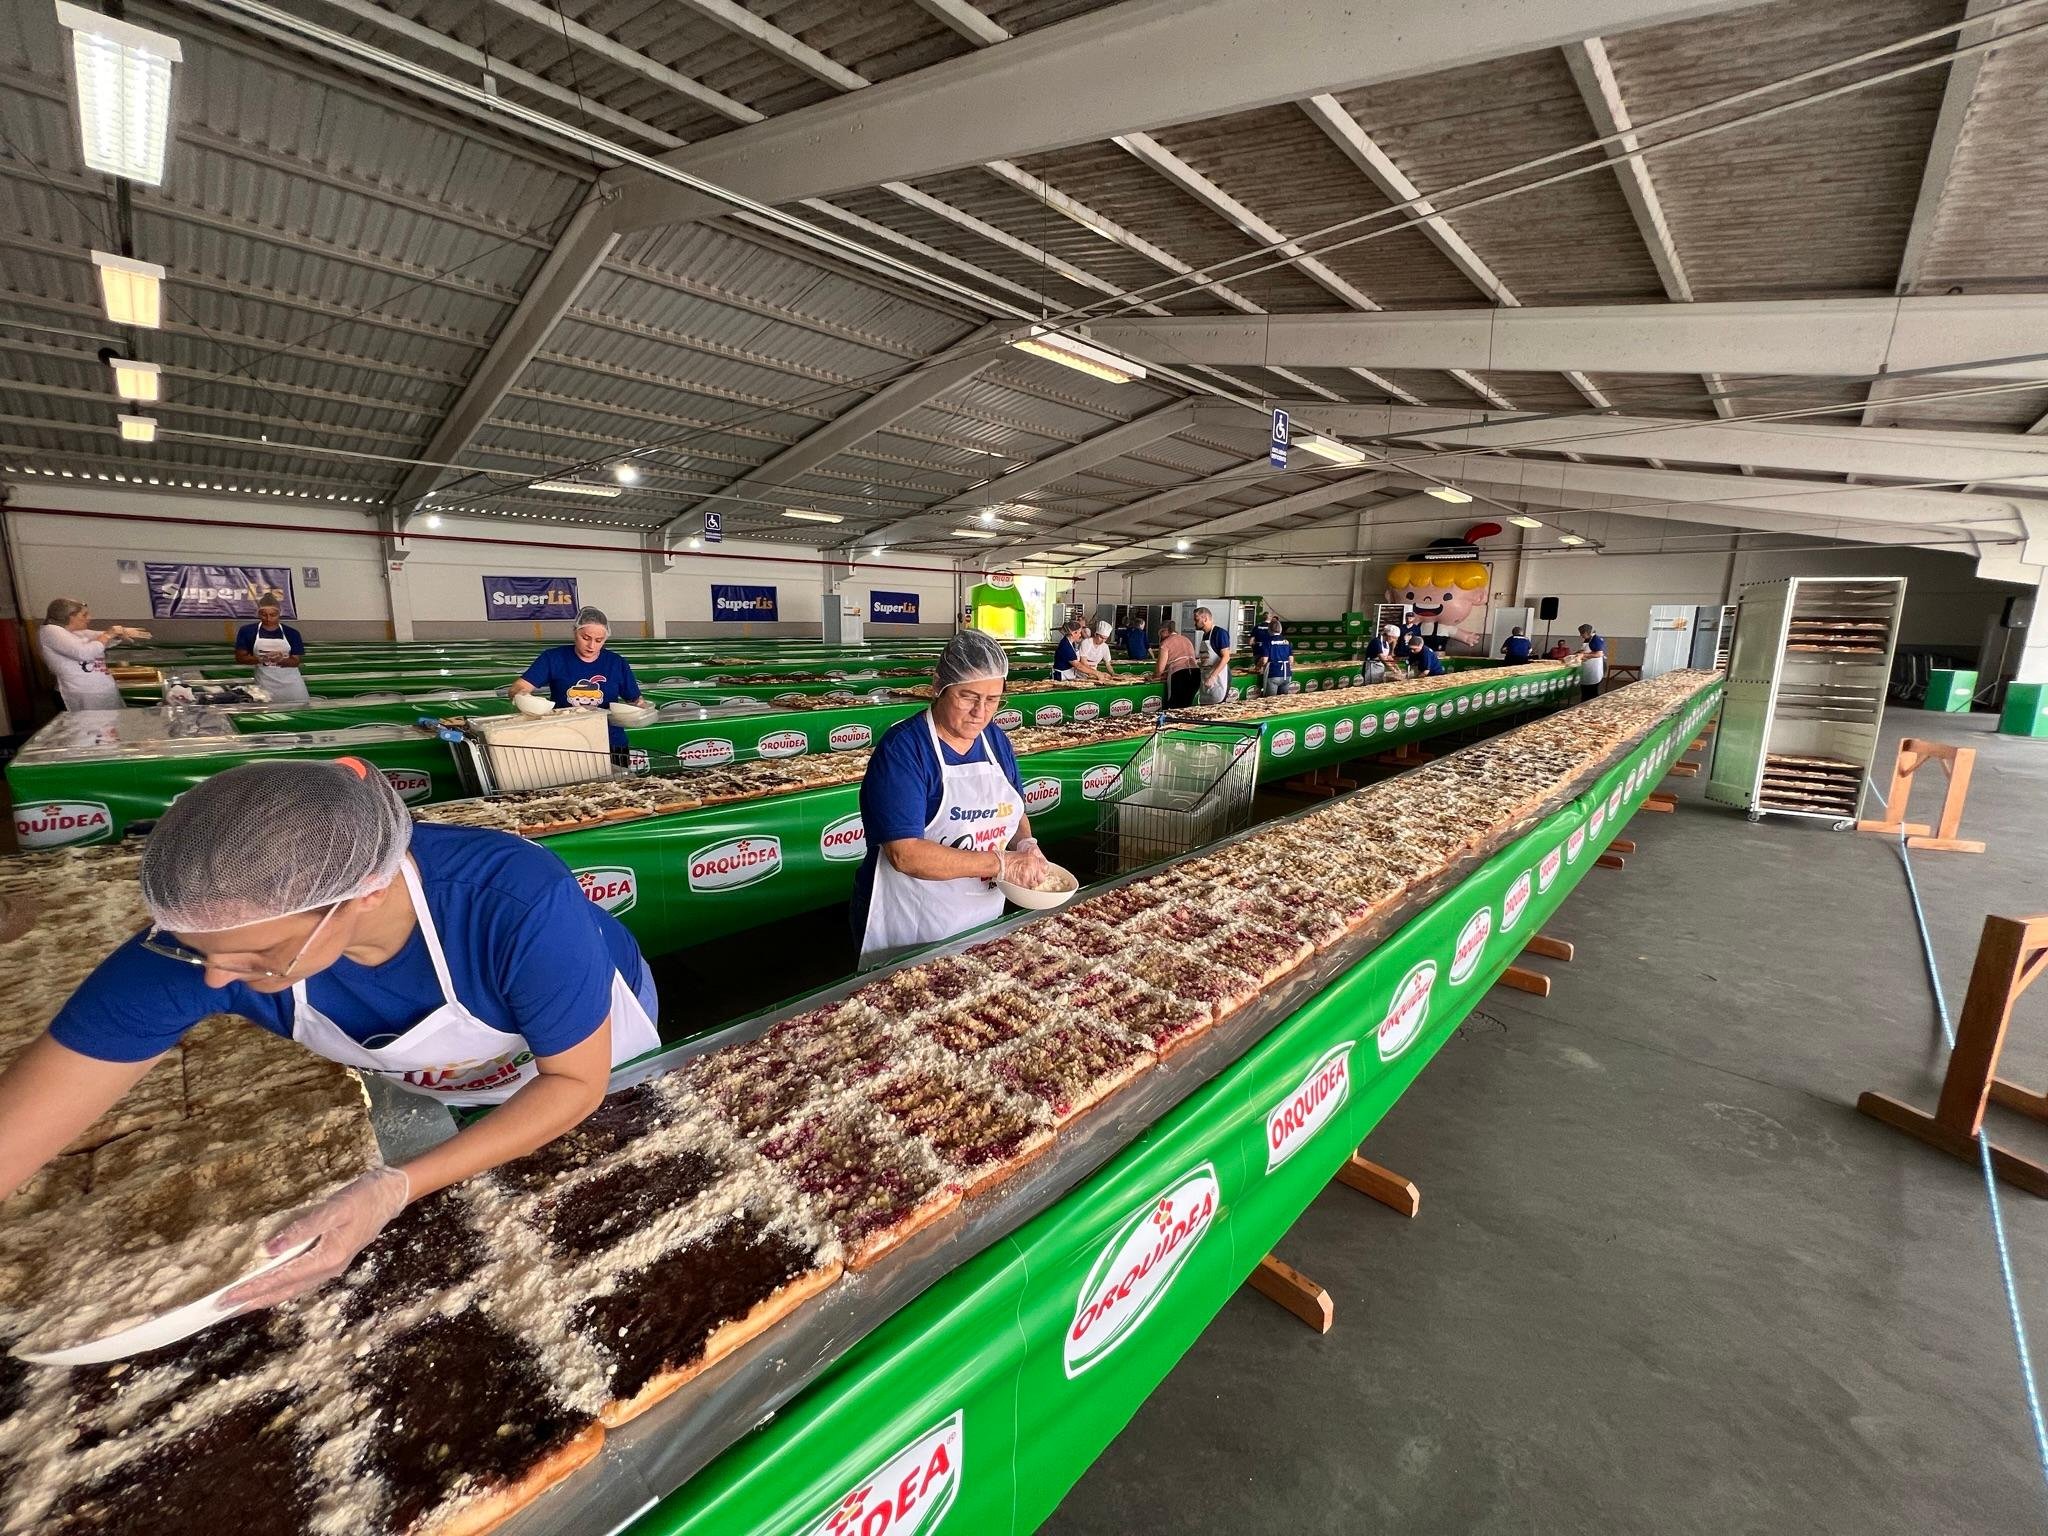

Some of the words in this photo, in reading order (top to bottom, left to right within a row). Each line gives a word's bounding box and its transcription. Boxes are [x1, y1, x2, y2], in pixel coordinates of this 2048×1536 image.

[493, 589, 572, 608] SuperLis
[717, 597, 773, 611] SuperLis
[874, 602, 916, 614] SuperLis
[760, 739, 806, 750] ORQUIDEA
[831, 732, 870, 743] ORQUIDEA
[1023, 787, 1059, 803] RQUIDEA
[950, 802, 1014, 822] SuperLis
[17, 812, 105, 836] QUIDEA
[824, 829, 863, 848] ORQU
[975, 826, 1007, 844] MAIOR
[692, 847, 777, 878] ORQUIDEA
[584, 880, 631, 902] IDEA
[1272, 1058, 1345, 1150] ORQUIDEA
[1072, 1192, 1212, 1341] ORQUIDEA
